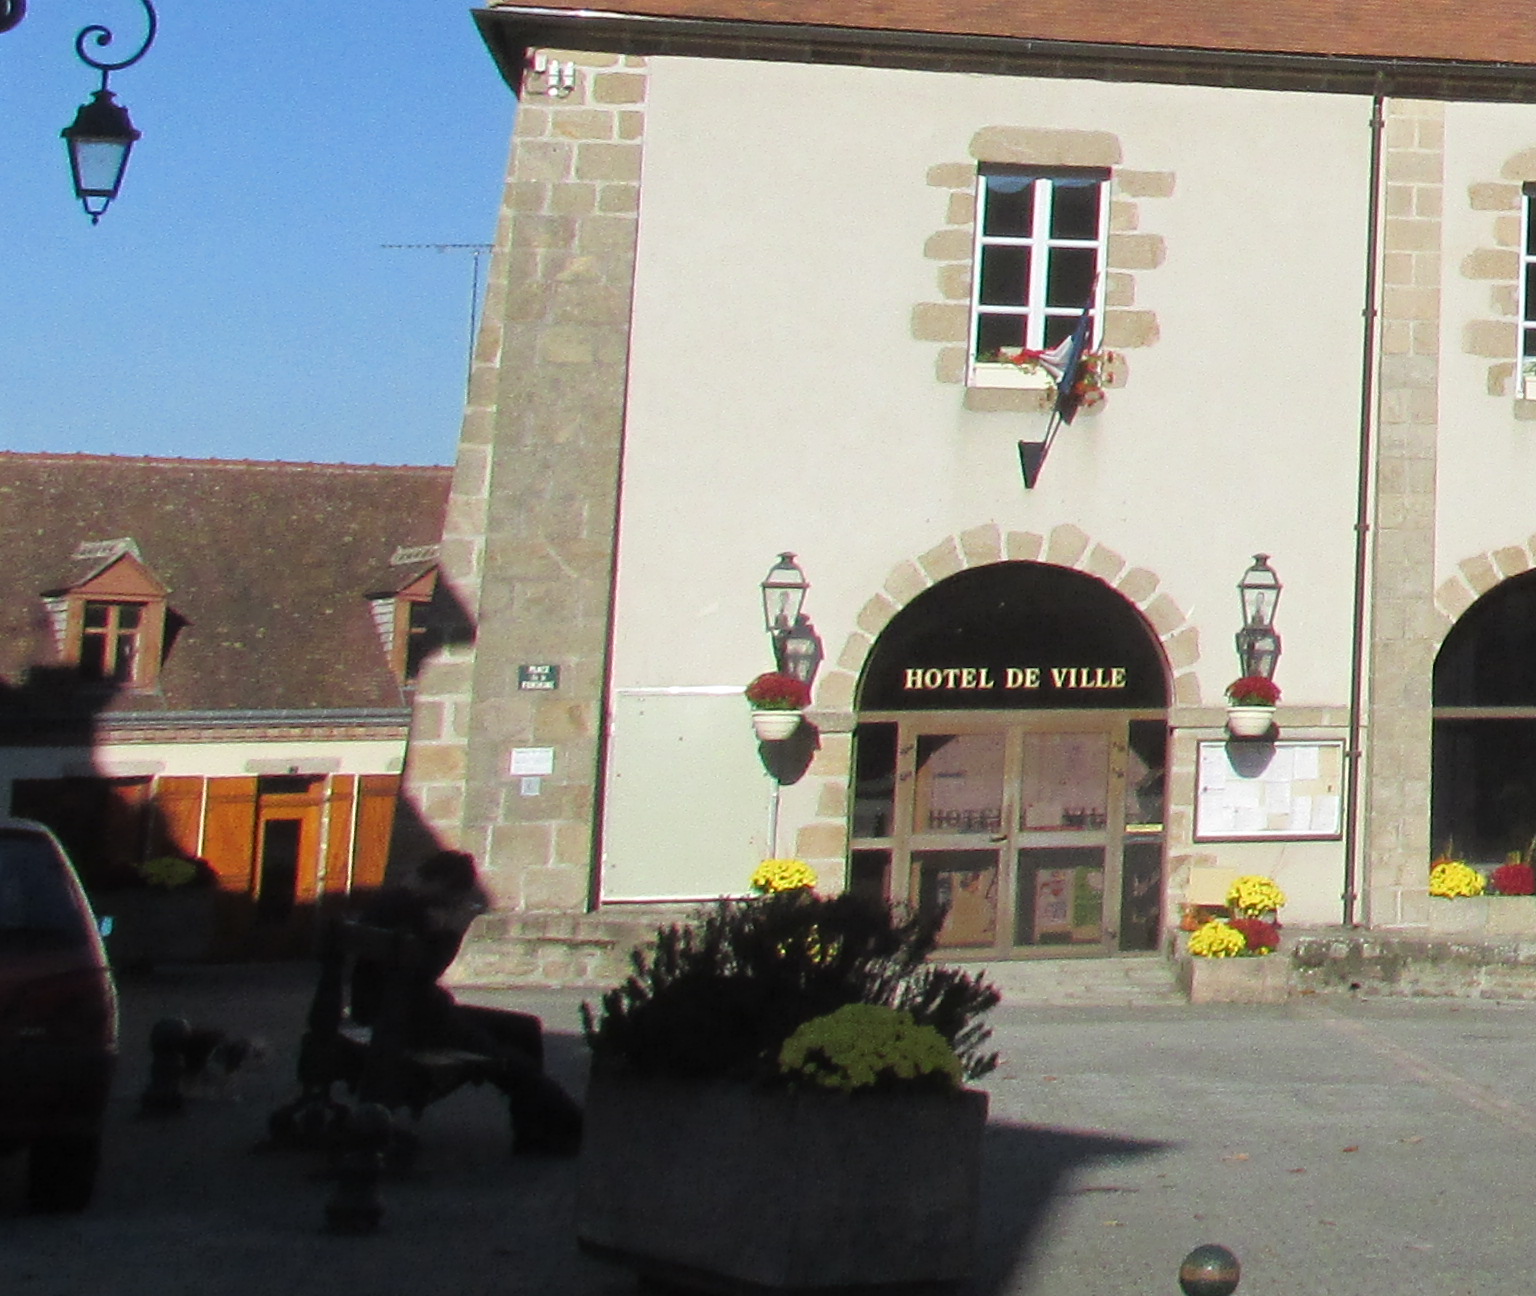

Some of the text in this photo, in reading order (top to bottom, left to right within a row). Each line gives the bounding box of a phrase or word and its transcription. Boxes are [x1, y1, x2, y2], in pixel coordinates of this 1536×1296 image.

[904, 667, 1128, 689] HOTEL DE VILLE
